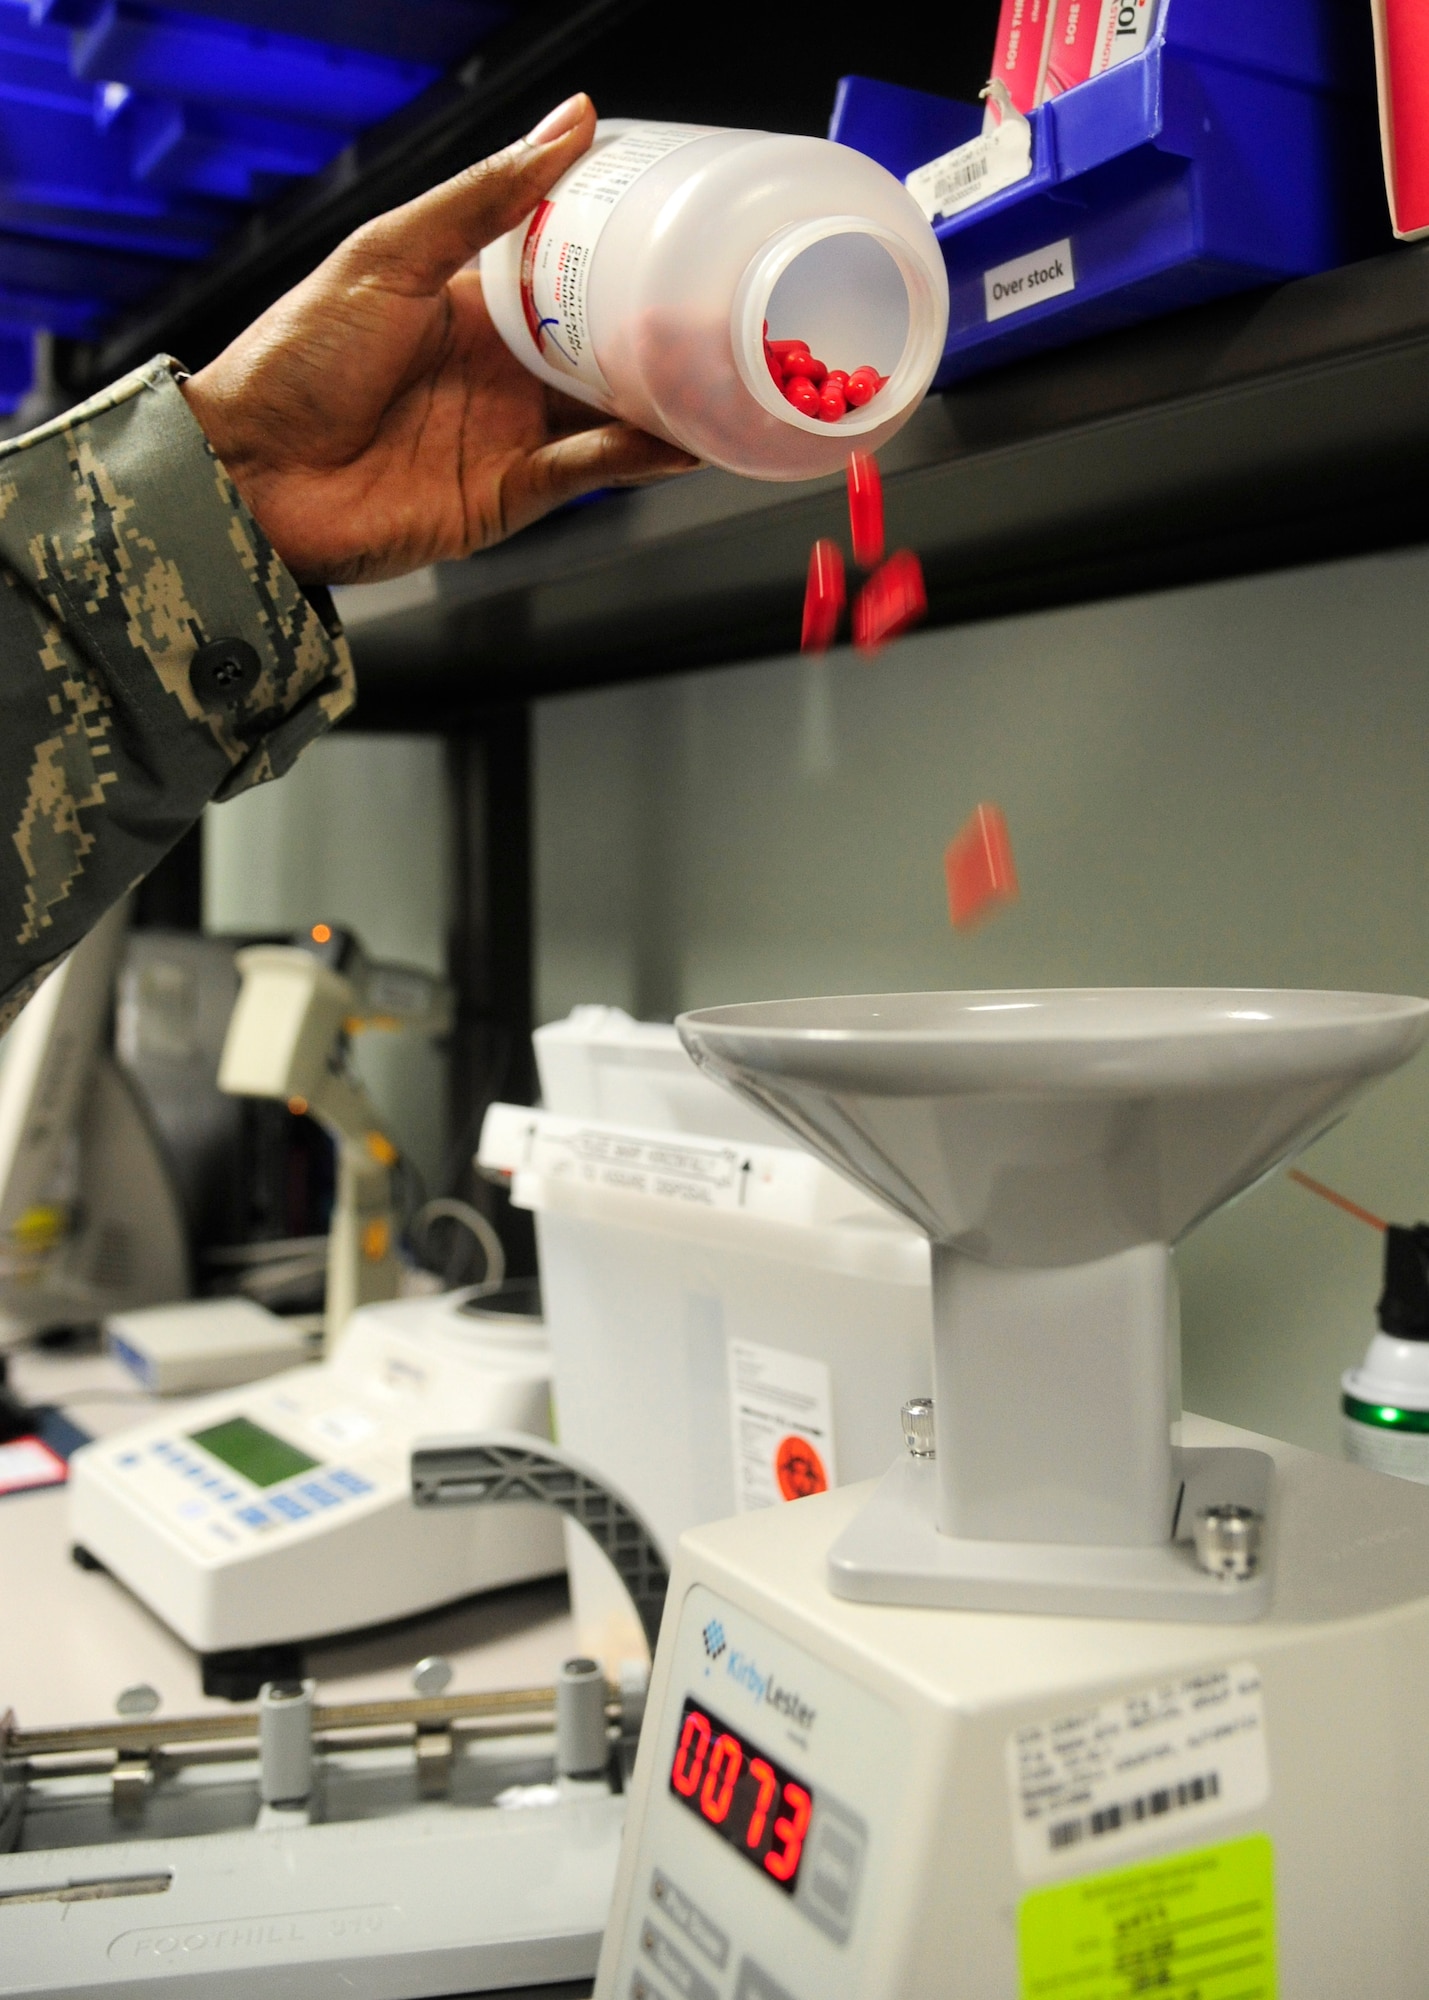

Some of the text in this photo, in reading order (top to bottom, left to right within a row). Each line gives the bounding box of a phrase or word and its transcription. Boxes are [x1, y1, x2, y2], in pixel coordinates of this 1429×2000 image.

[1064, 4, 1081, 45] SORE
[1005, 29, 1021, 70] SORE
[558, 242, 569, 271] 500
[562, 244, 575, 317] Capsules
[568, 246, 582, 350] CEPHALEXIN
[992, 259, 1065, 301] Over stock
[671, 1711, 813, 1881] 0073
[133, 1922, 305, 1958] FOOTHILL
